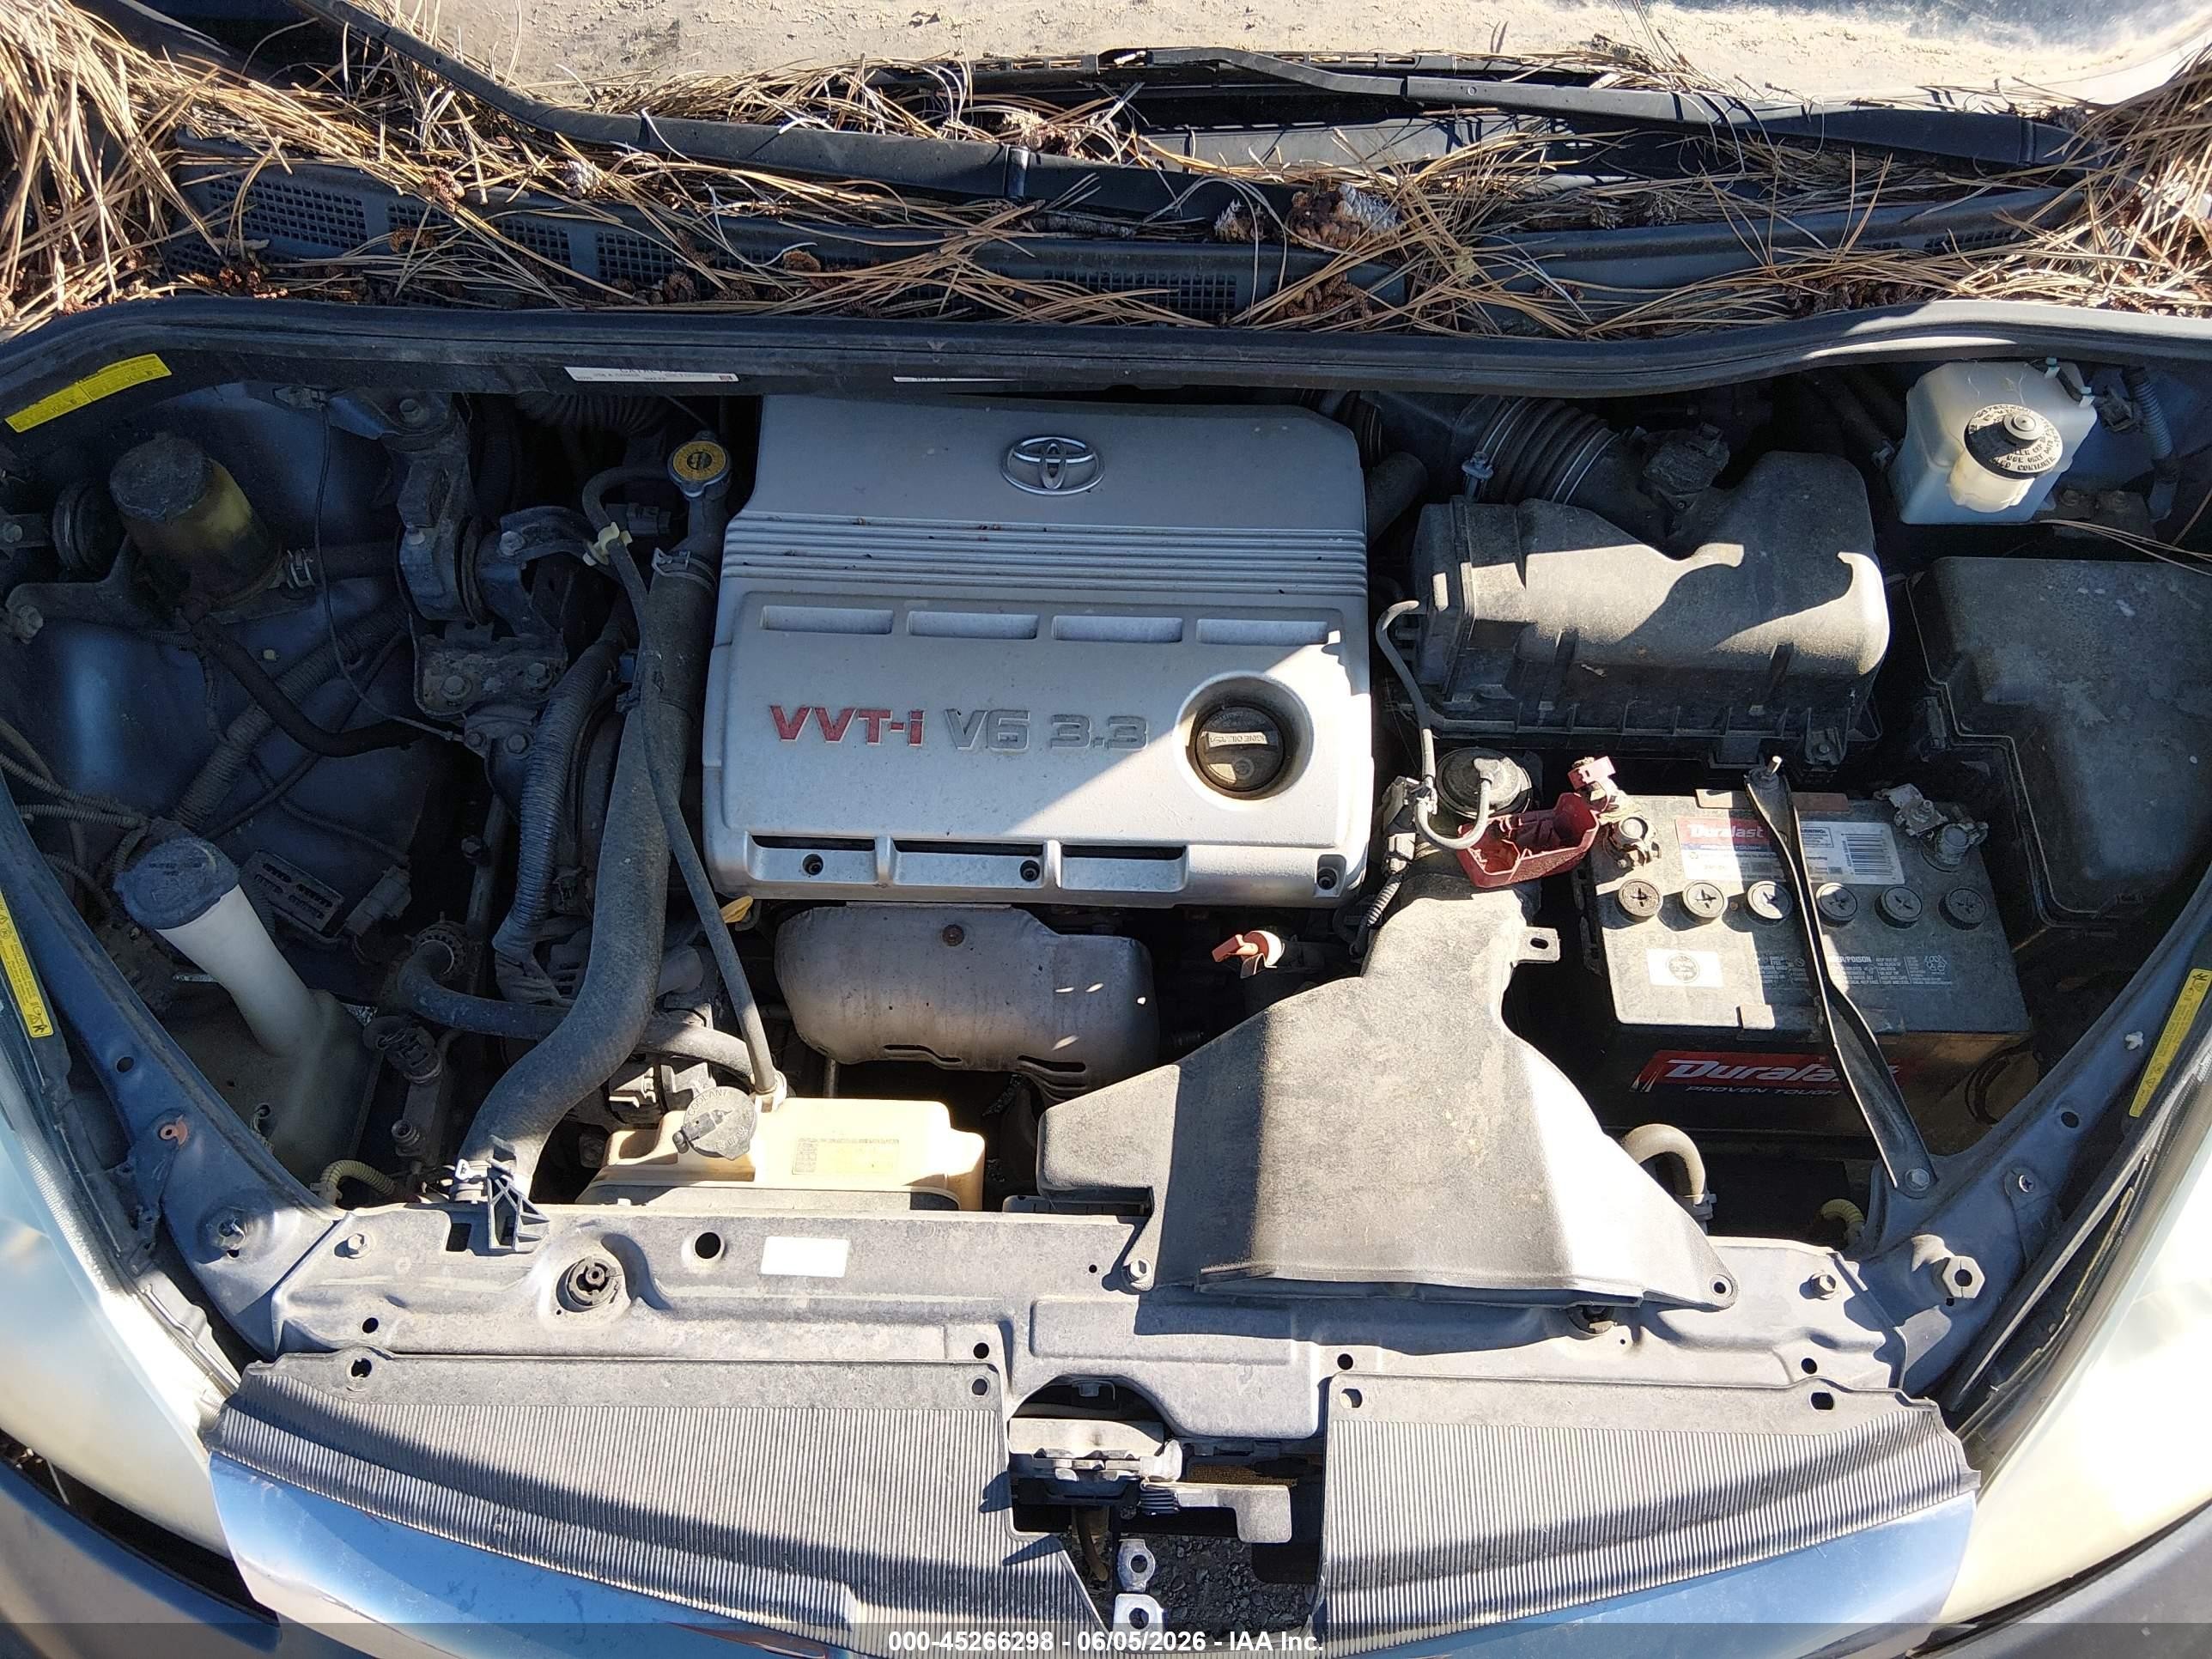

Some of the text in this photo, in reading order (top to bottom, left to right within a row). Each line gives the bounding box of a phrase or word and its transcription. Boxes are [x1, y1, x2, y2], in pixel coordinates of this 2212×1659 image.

[770, 706, 1148, 751] VVT-i V6 3.3
[688, 1089, 728, 1115] COOLANT
[1684, 1085, 1841, 1097] PROVEN TOUGH
